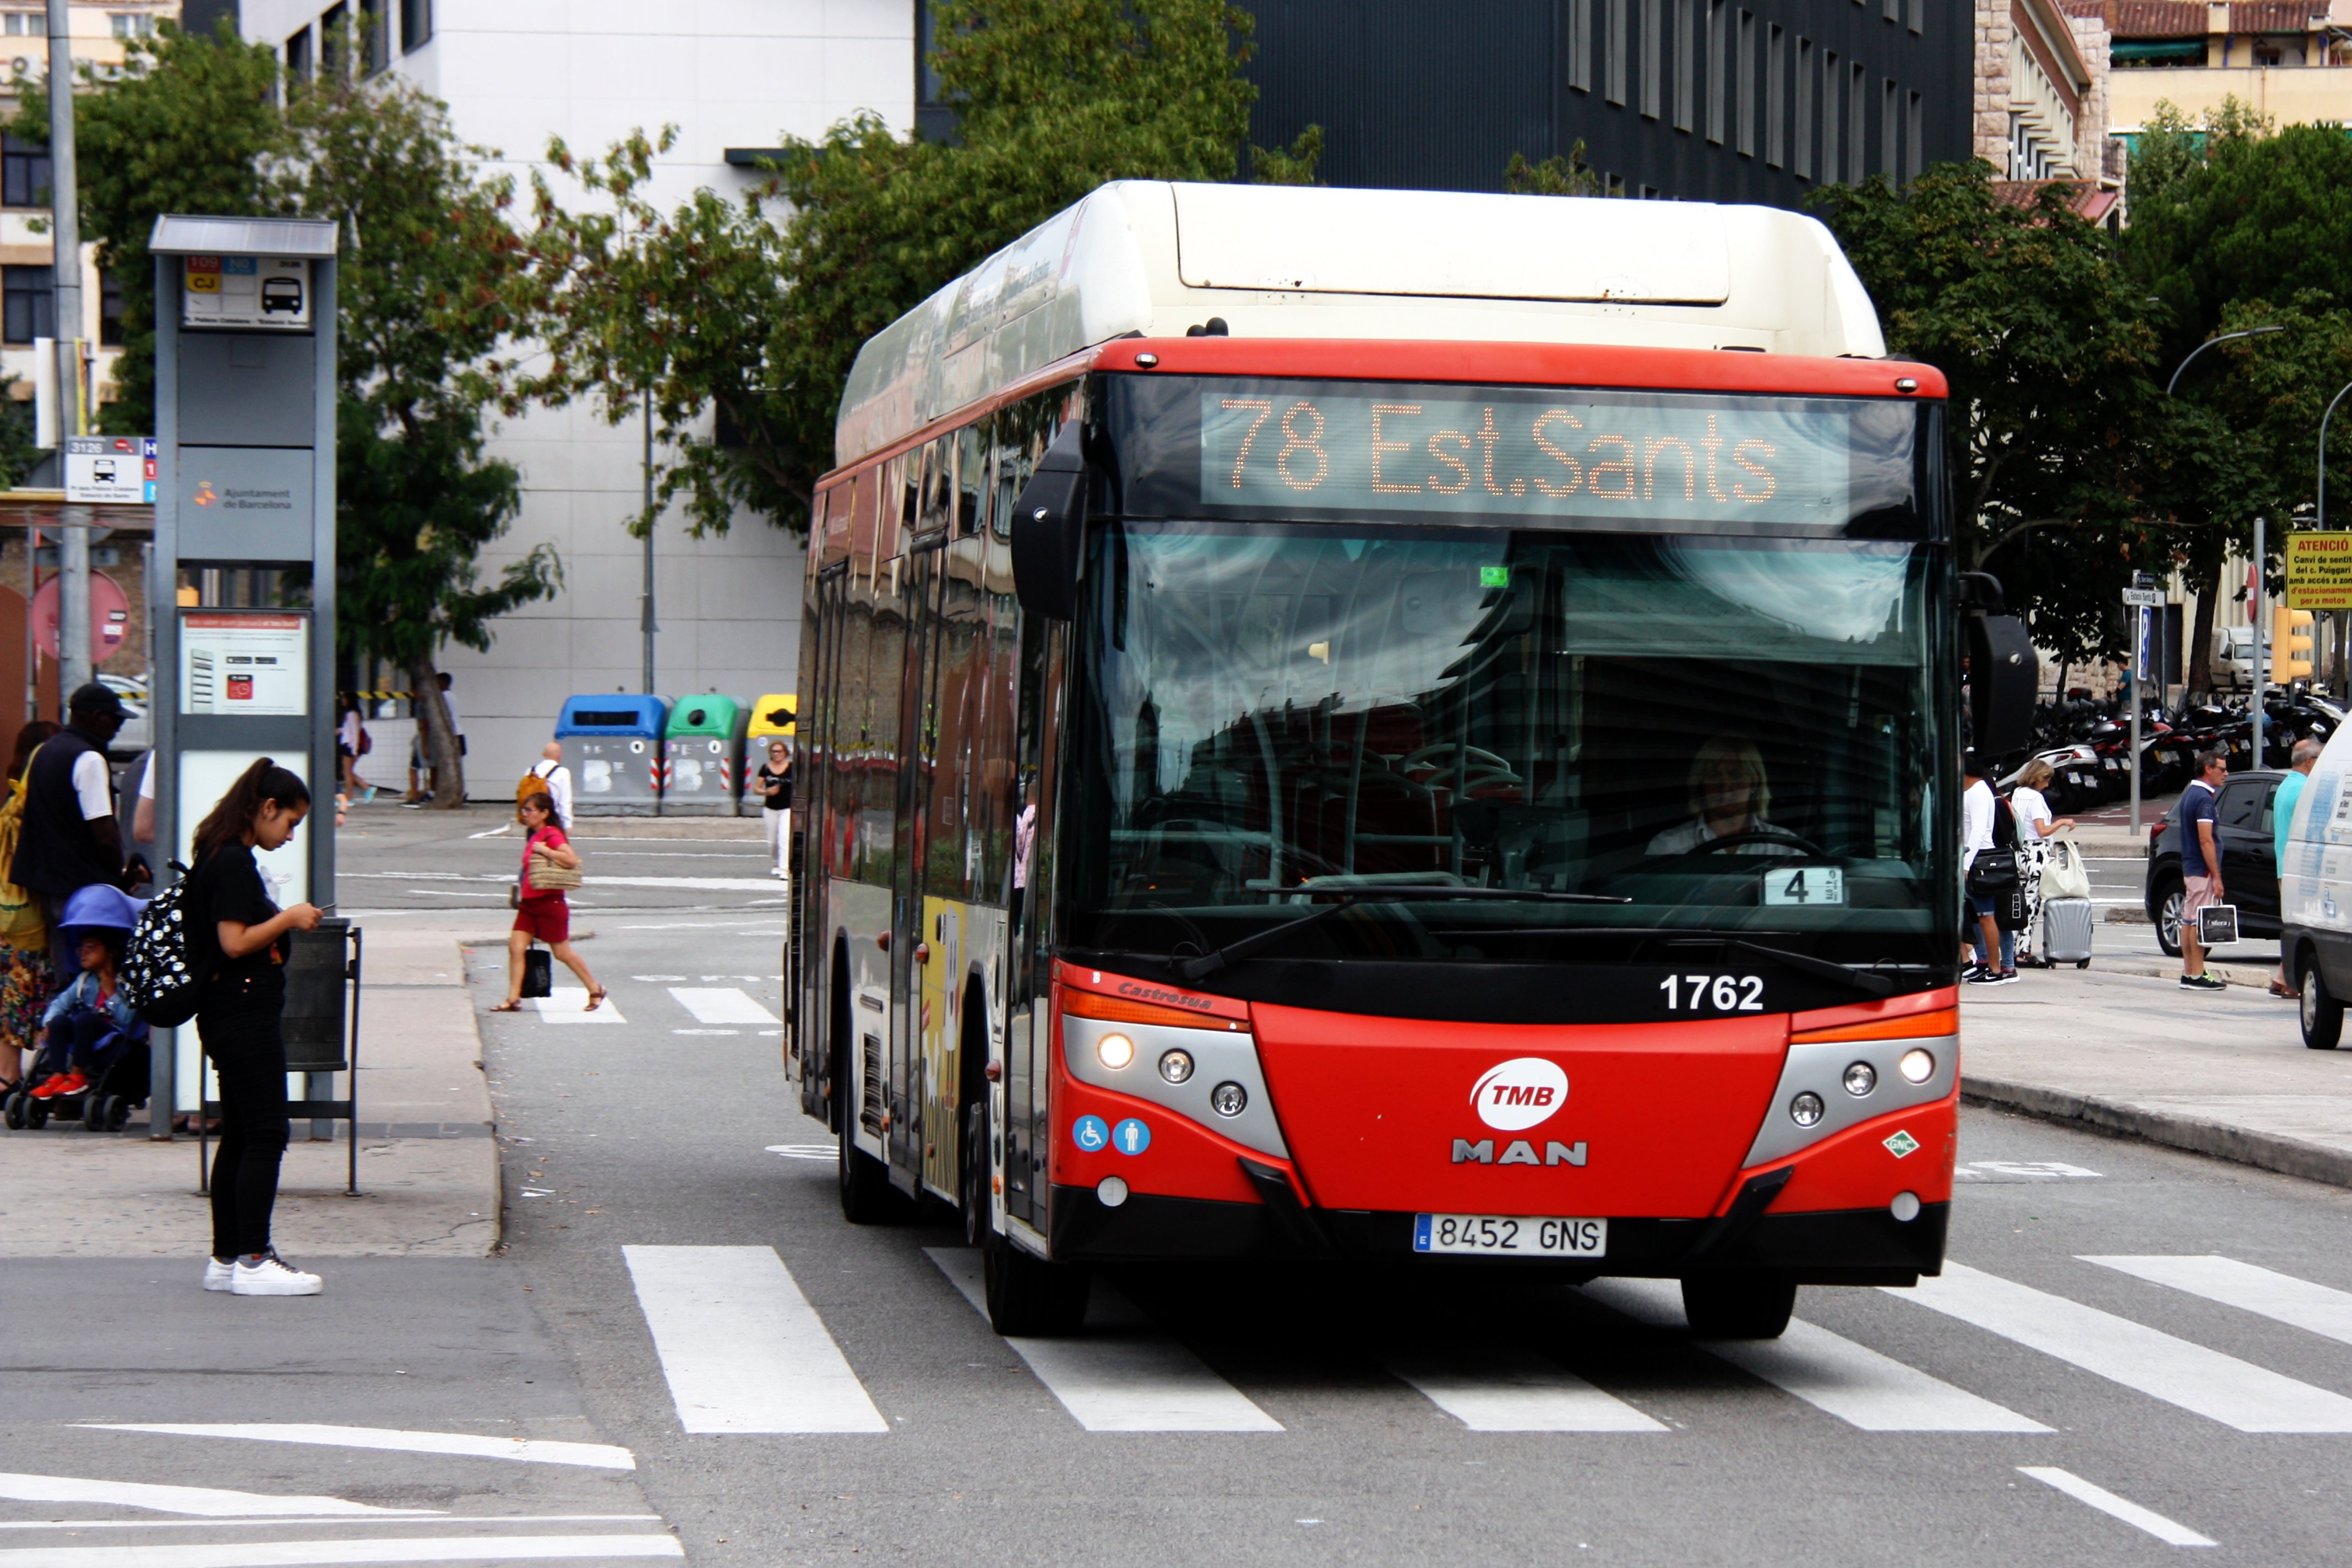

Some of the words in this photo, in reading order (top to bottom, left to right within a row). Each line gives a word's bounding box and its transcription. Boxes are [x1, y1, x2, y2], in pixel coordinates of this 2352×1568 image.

[70, 442, 104, 454] 3126
[1222, 399, 1328, 491] 78
[225, 488, 290, 498] Ajuntament
[238, 500, 292, 509] Barcelona
[2298, 538, 2349, 551] ATENCIÓ
[1784, 870, 1809, 903] 4
[1118, 982, 1213, 1010] Castrosua
[1660, 974, 1763, 1010] 1762
[1493, 1085, 1555, 1106] TMB
[1452, 1139, 1588, 1166] MAN
[1889, 1139, 1913, 1151] GNC
[1419, 1235, 1427, 1245] E
[1439, 1218, 1520, 1249] 8452
[1540, 1221, 1599, 1251] GNS
